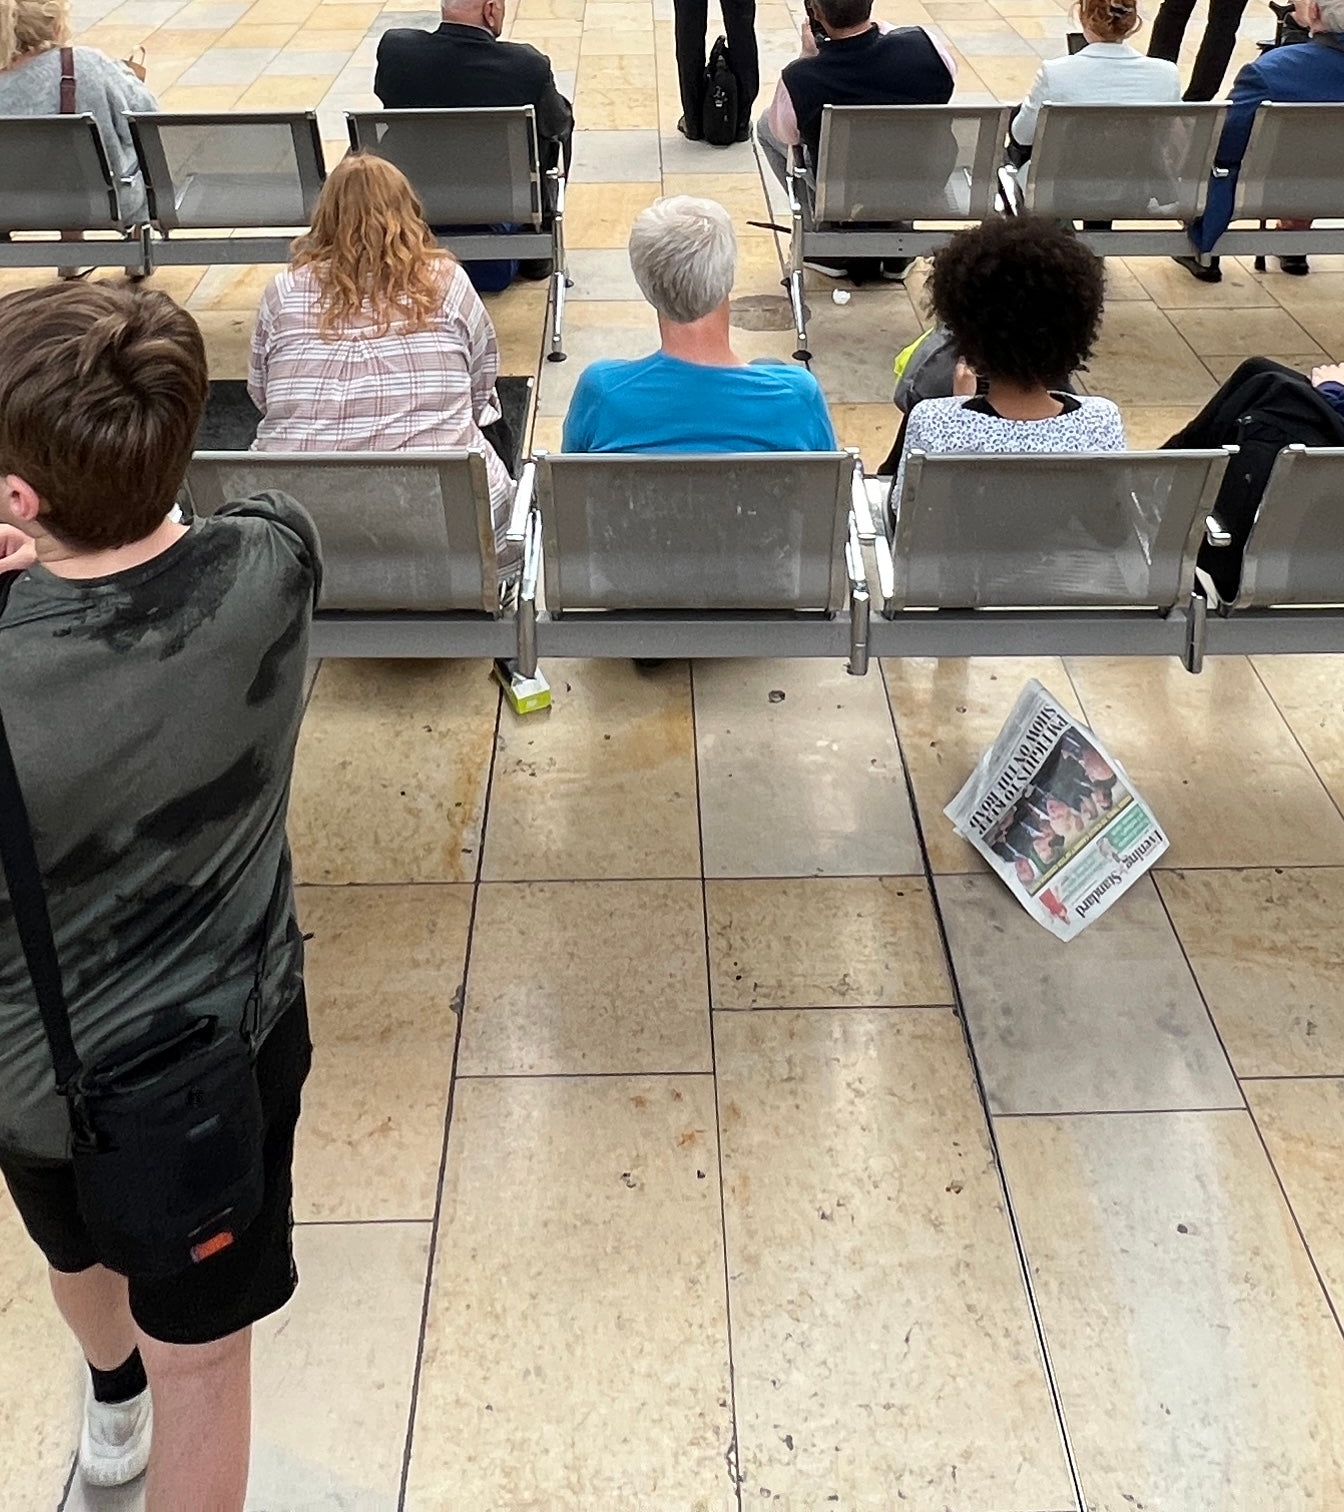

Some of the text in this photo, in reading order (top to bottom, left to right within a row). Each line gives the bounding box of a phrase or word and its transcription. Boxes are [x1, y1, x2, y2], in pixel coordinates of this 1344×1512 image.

[1046, 714, 1069, 737] PM
[969, 705, 1056, 828] SHOW ON THE ROAD
[1017, 732, 1053, 782] FIGHTS
[1004, 782, 1023, 801] TO
[1121, 829, 1163, 869] Evening
[1075, 870, 1122, 918] Standard
